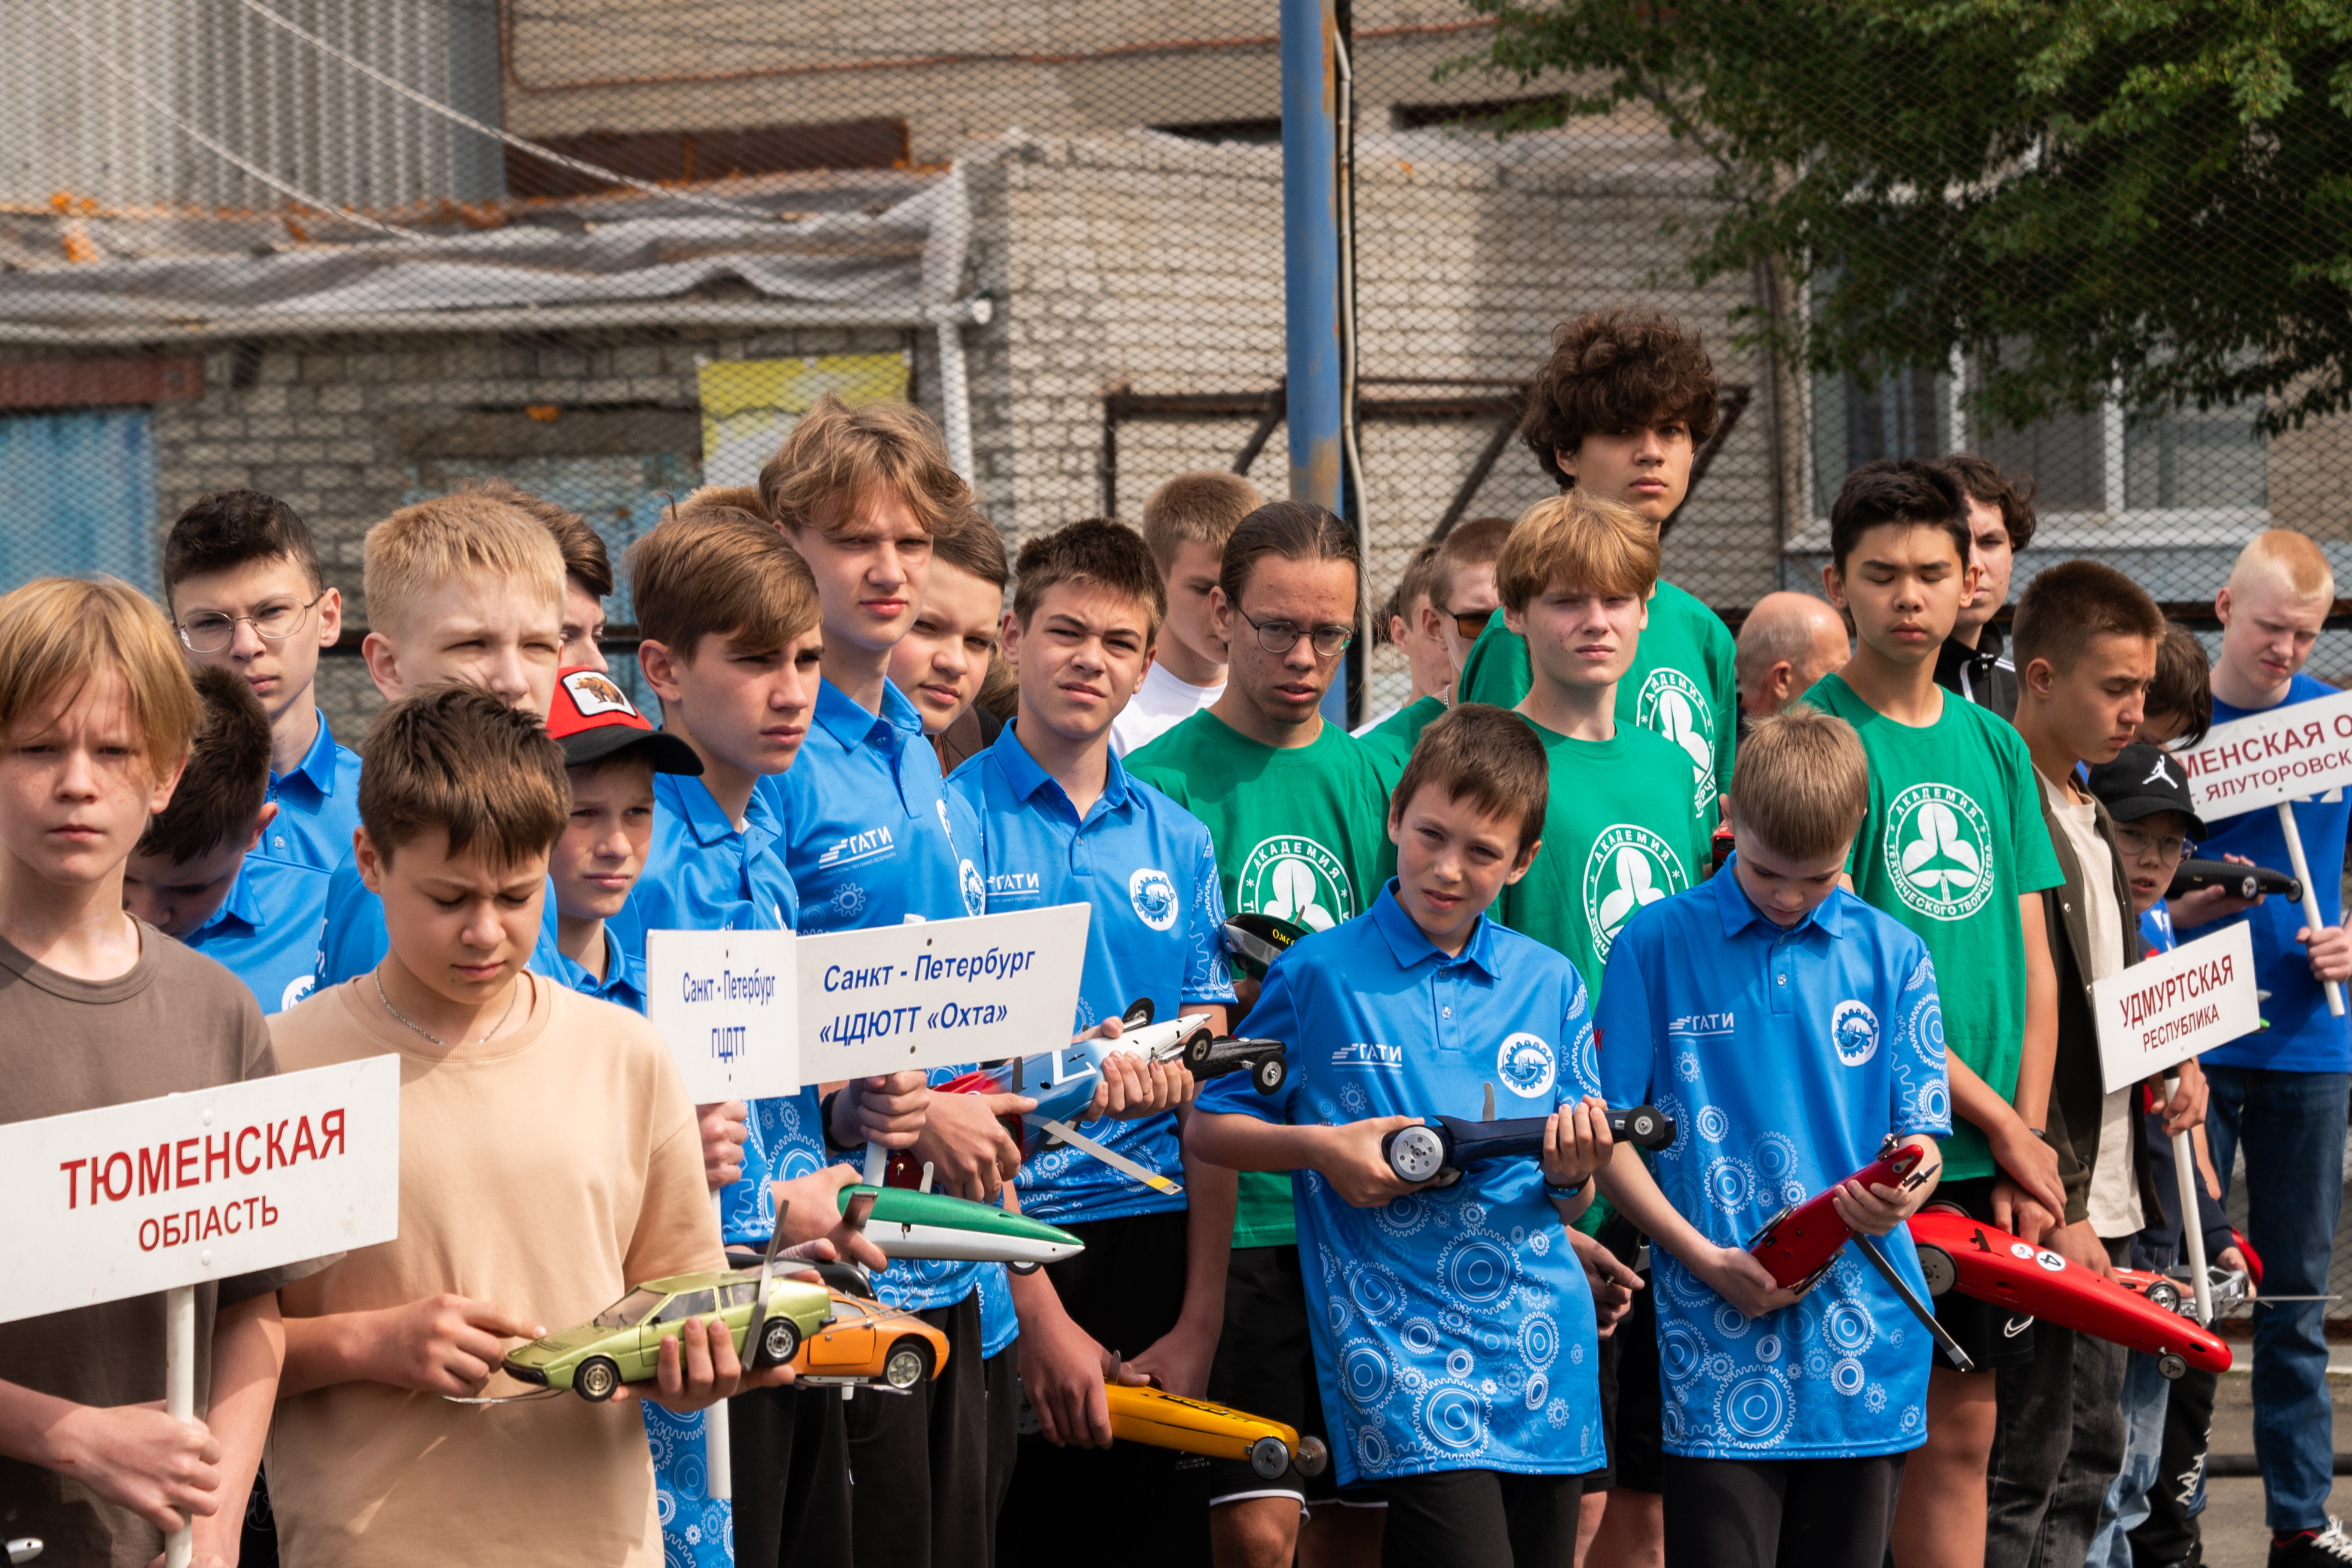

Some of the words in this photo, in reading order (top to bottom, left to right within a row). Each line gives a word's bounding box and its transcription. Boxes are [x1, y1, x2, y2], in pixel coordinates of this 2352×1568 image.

[1644, 673, 1704, 709] ААДЕМИЯ
[1895, 788, 1977, 818] АКАДЕМИЯ
[849, 826, 893, 855] ГАТИ
[1594, 829, 1670, 863] АКАДЕМИЯ
[1254, 841, 1340, 879] АКАДЕМИЯ
[1888, 843, 1957, 915] ТЕХНИЧЕСКОГО
[1958, 844, 1992, 913] ТВОРЧЕСТВА
[996, 872, 1040, 890] ГАТИ
[683, 972, 714, 1004] Санкт
[723, 968, 776, 1006] Петербург
[824, 963, 893, 993] Санкт
[914, 947, 1036, 986] Петербург
[2119, 954, 2234, 1030] УДМУРТСКАЯ
[819, 1006, 921, 1047] «ЦДЮТТ
[927, 1002, 1008, 1031] «Охта»
[1693, 1012, 1734, 1031] ГАТИ
[2142, 1003, 2220, 1059] РЕСПУБЛИКА
[711, 1026, 746, 1064] ГЦДТТ
[1359, 1043, 1402, 1062] ГАТИ
[60, 1108, 346, 1210] ТЮМЕНСКАЯ
[138, 1195, 279, 1252] ОБЛАСТЬ
[2040, 1254, 2062, 1267] 4
